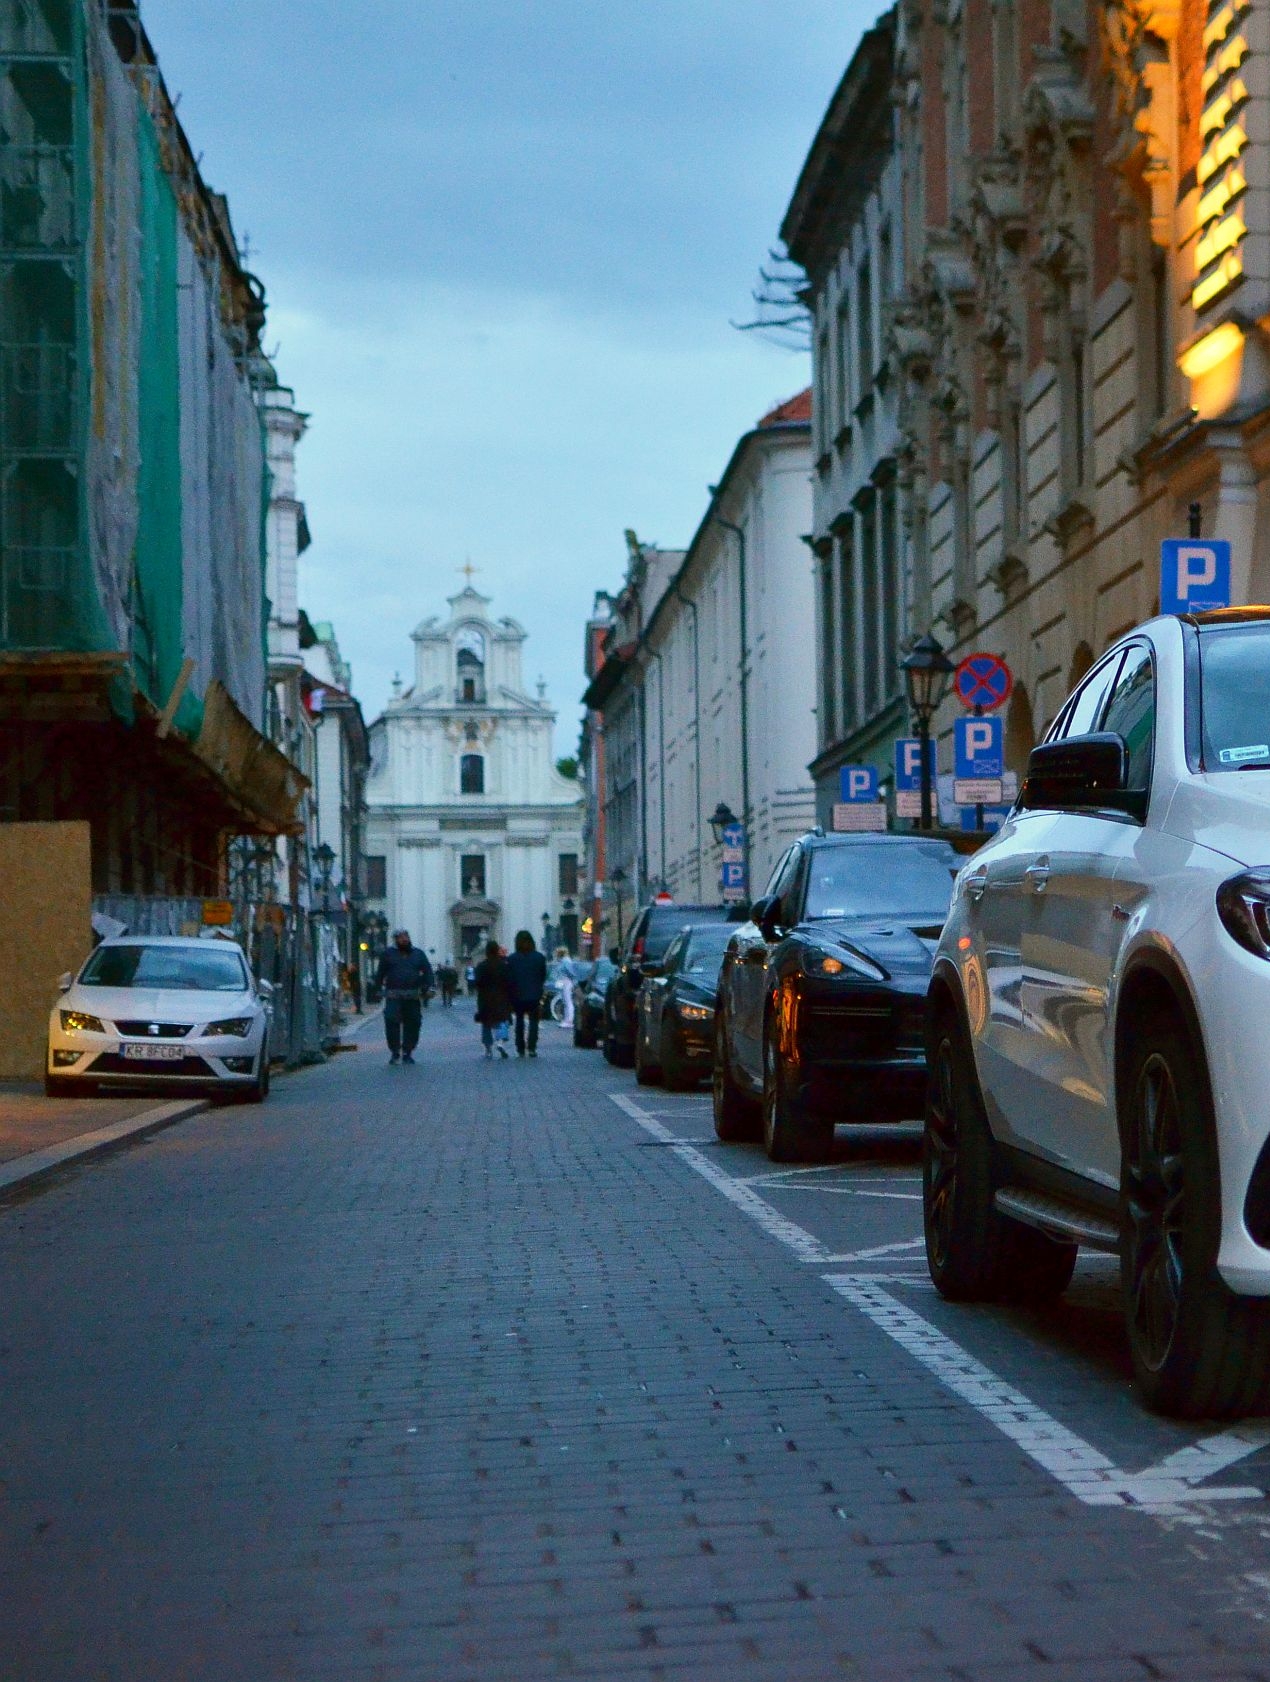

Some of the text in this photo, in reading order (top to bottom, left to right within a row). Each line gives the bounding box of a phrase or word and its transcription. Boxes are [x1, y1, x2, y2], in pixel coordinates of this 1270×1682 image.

[1176, 547, 1216, 600] P
[965, 722, 992, 760] P
[849, 769, 871, 799] P
